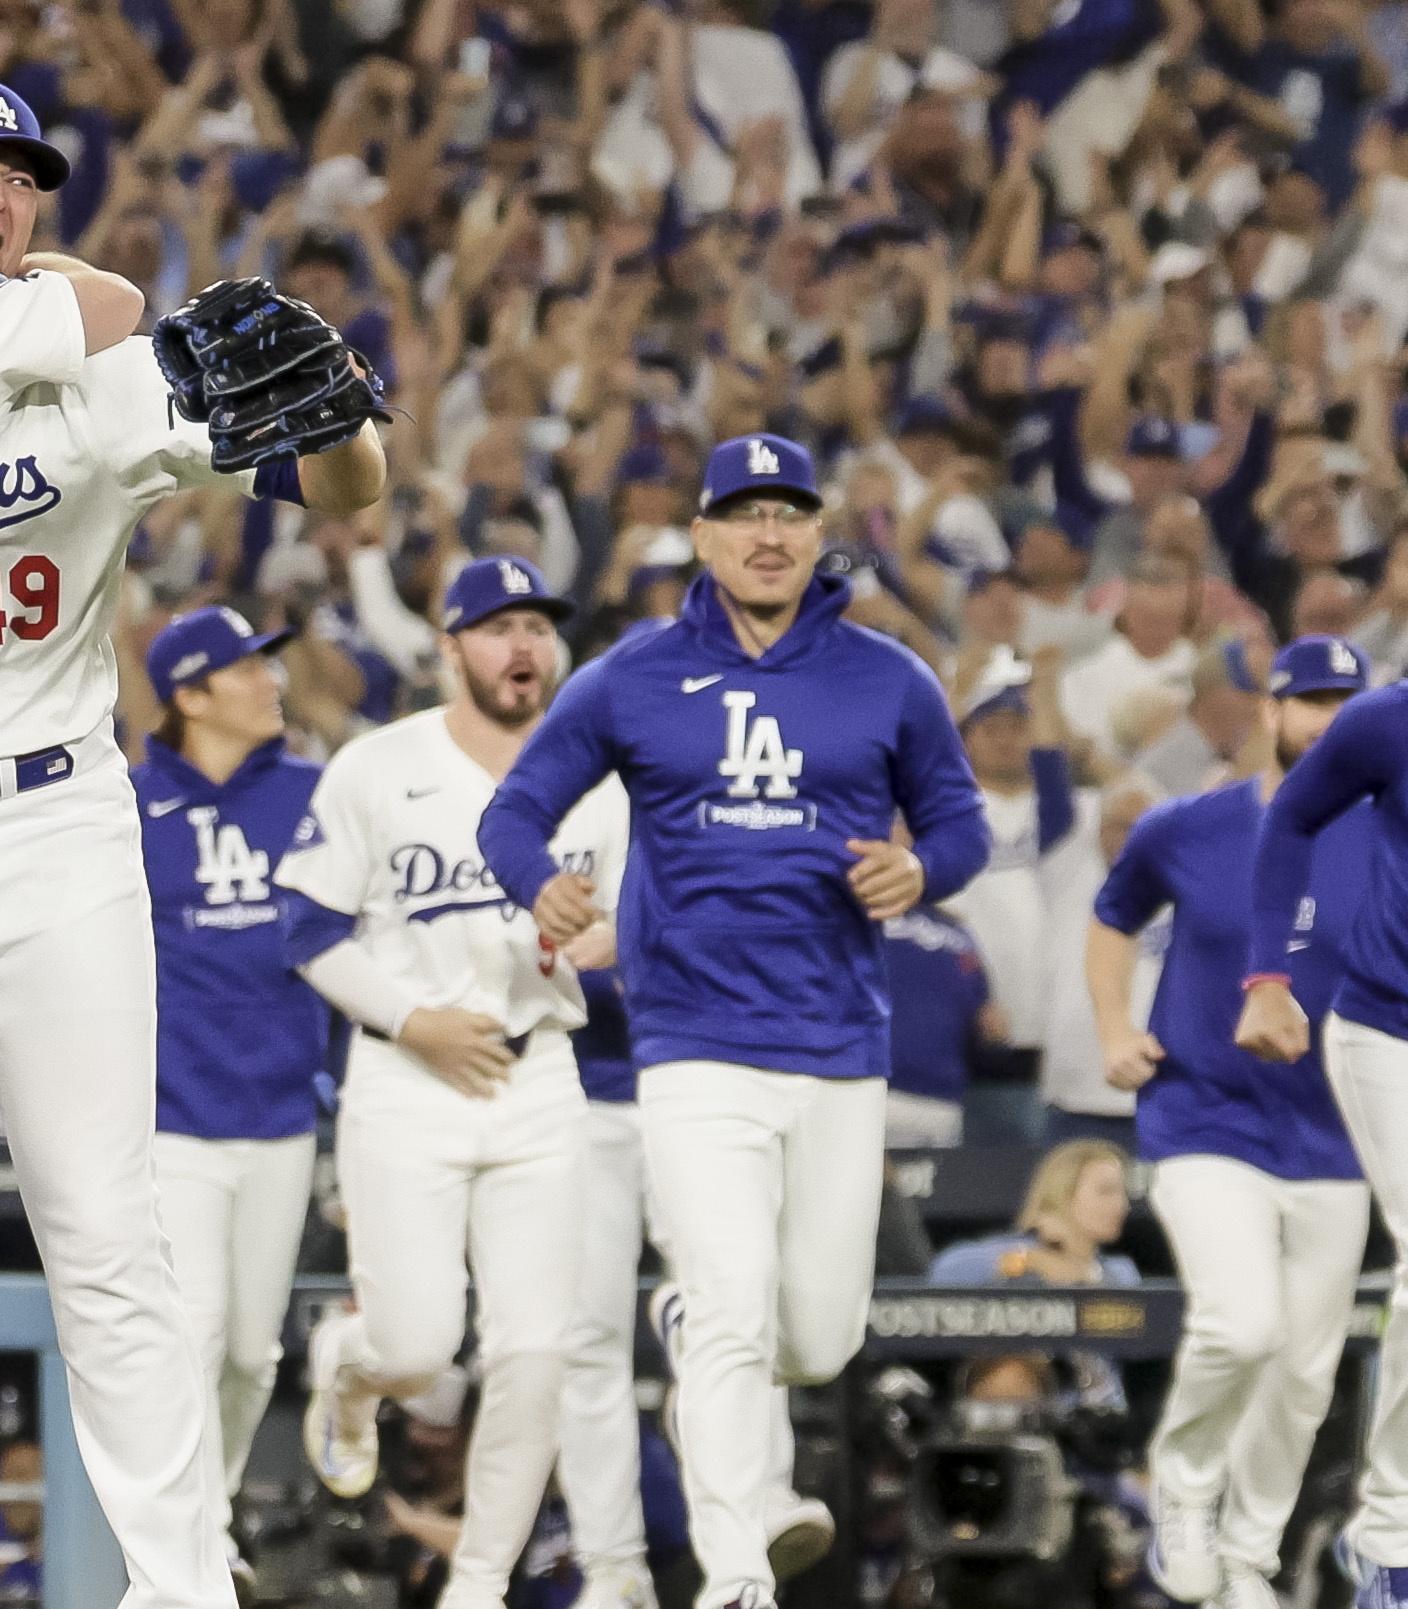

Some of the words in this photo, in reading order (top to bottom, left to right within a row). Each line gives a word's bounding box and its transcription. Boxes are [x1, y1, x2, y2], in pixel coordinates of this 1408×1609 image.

[747, 439, 780, 474] LA
[498, 559, 532, 594] LA
[718, 690, 804, 799] LA
[187, 806, 269, 905] LA
